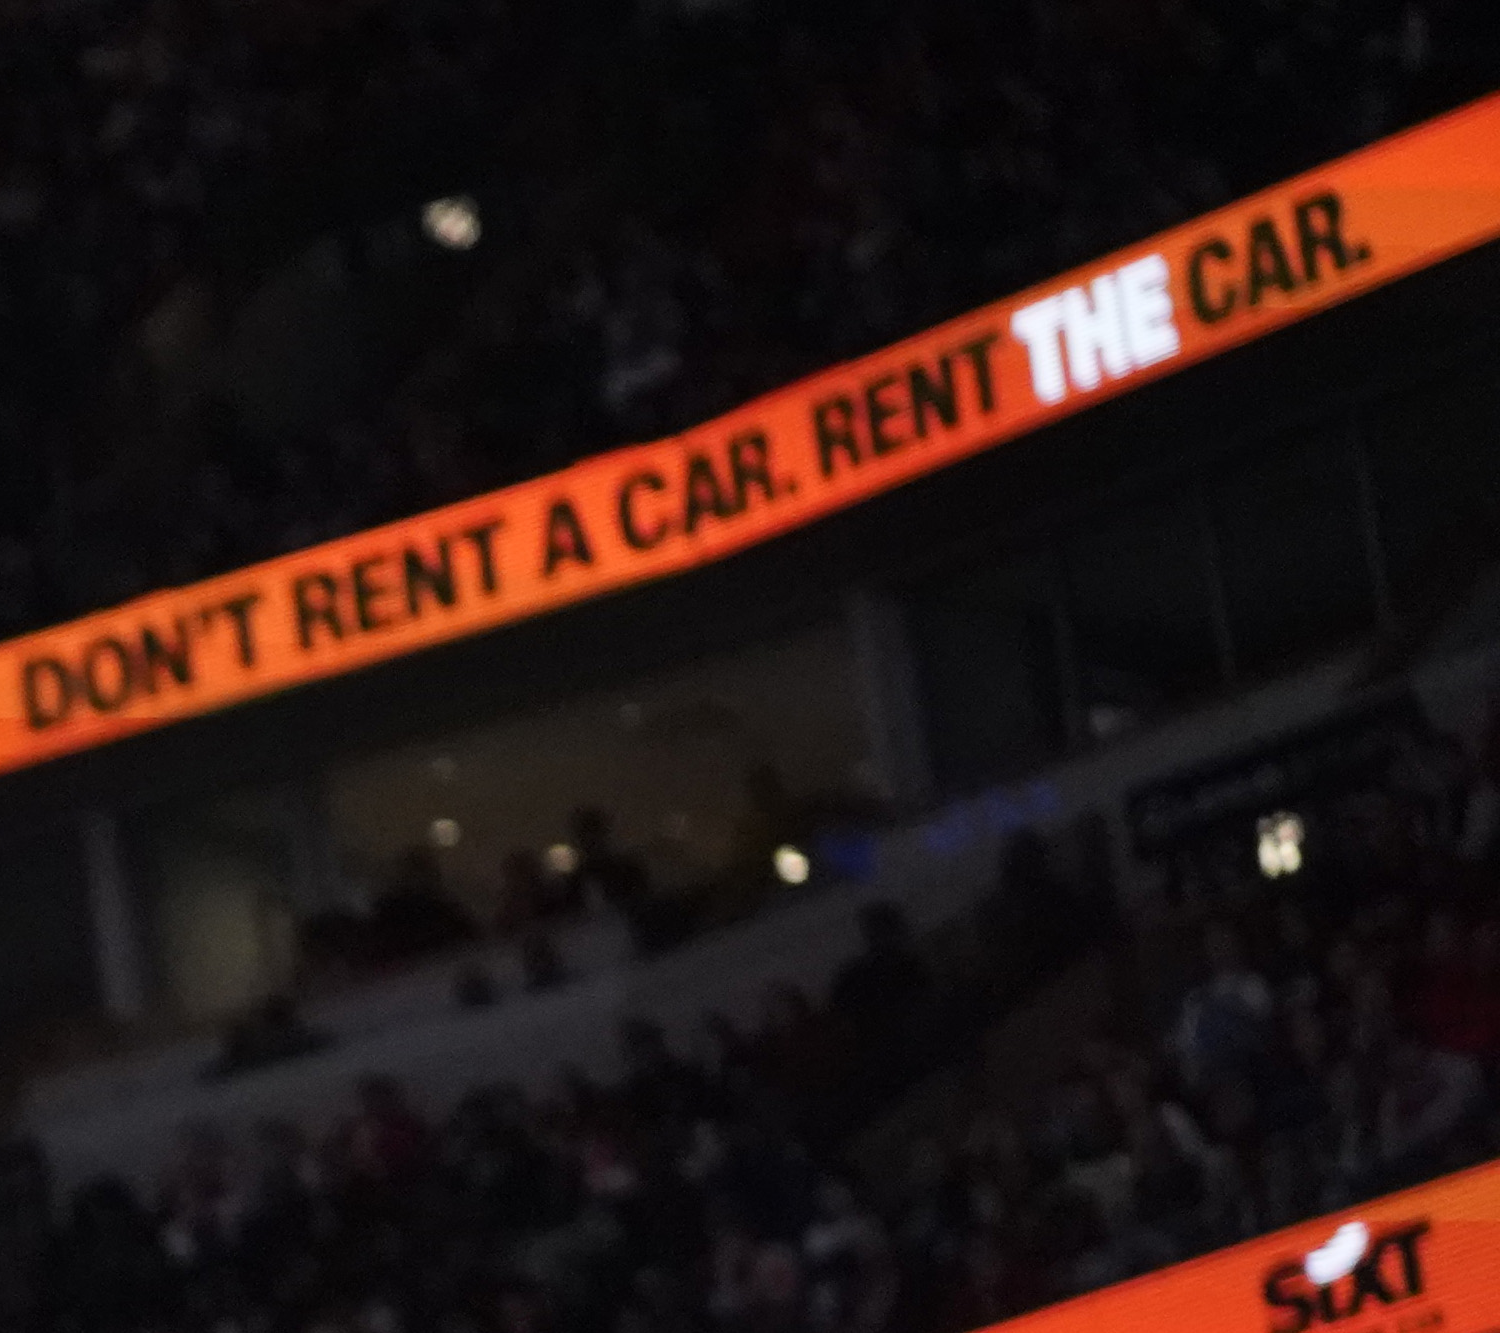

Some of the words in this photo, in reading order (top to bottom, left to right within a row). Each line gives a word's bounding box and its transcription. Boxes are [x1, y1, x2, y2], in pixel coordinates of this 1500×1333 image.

[20, 591, 265, 732] DON'T
[290, 517, 507, 651] RENT
[540, 498, 593, 580] A
[614, 428, 798, 550] CAR.
[811, 332, 1001, 481] RENT
[1009, 252, 1182, 406] THE
[1185, 188, 1375, 325] CAR.
